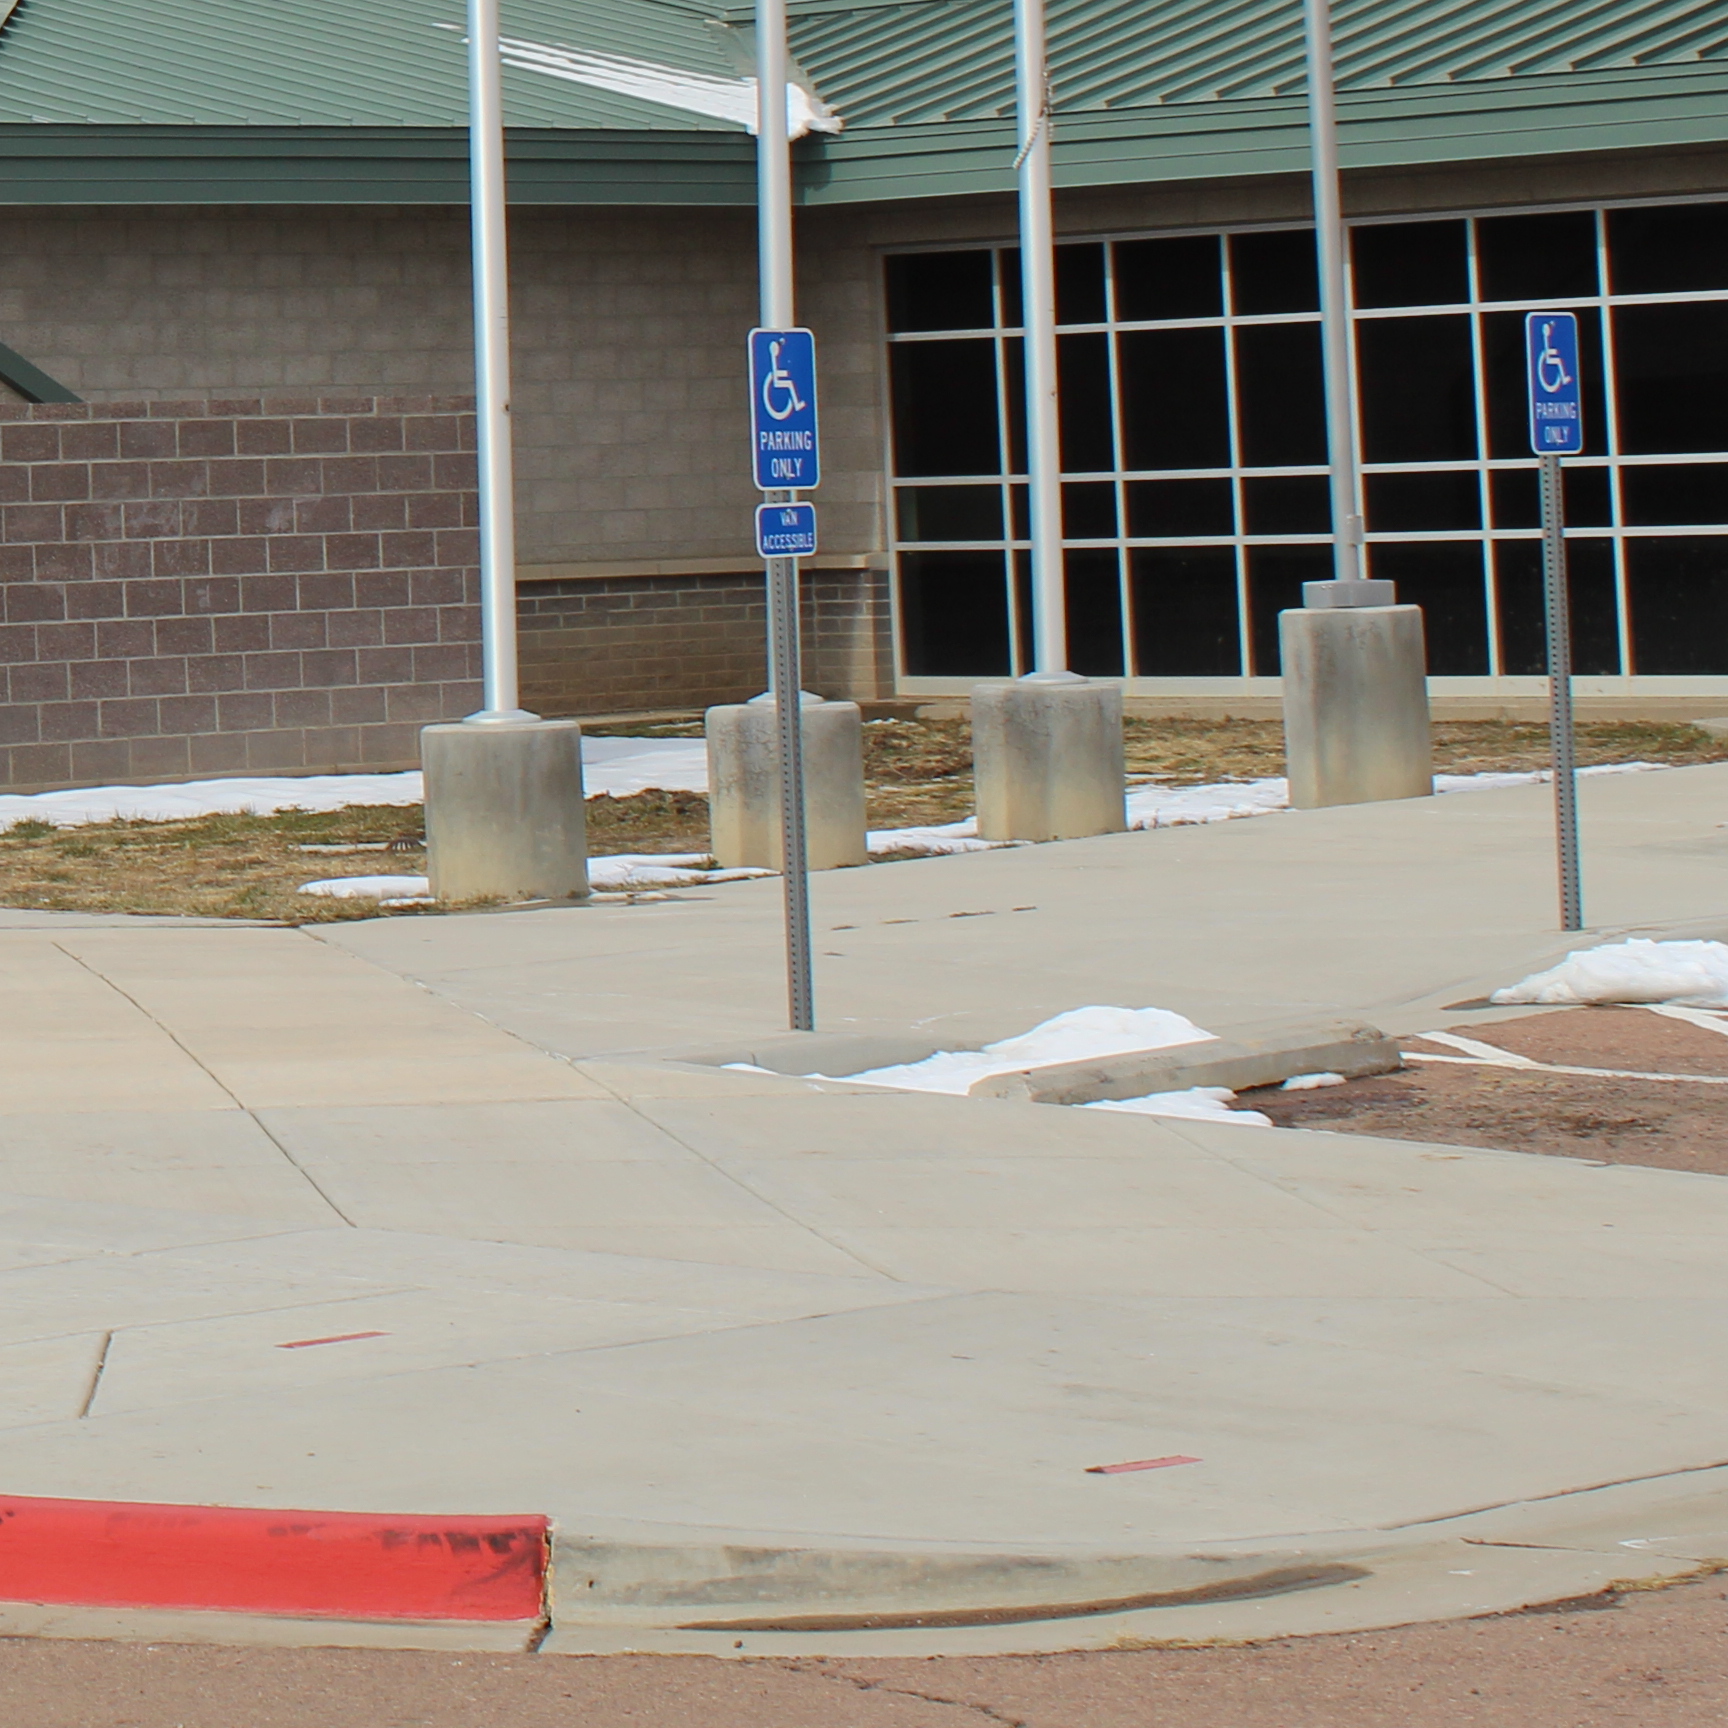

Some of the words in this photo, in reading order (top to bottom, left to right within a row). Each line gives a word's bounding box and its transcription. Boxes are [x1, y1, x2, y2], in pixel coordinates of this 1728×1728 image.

[1536, 402, 1576, 419] PARKING
[760, 430, 812, 450] PARKING
[1545, 426, 1569, 443] ONLY
[771, 458, 802, 478] ONLY
[780, 511, 798, 526] VAN
[763, 532, 813, 549] ACCESSIBLE
